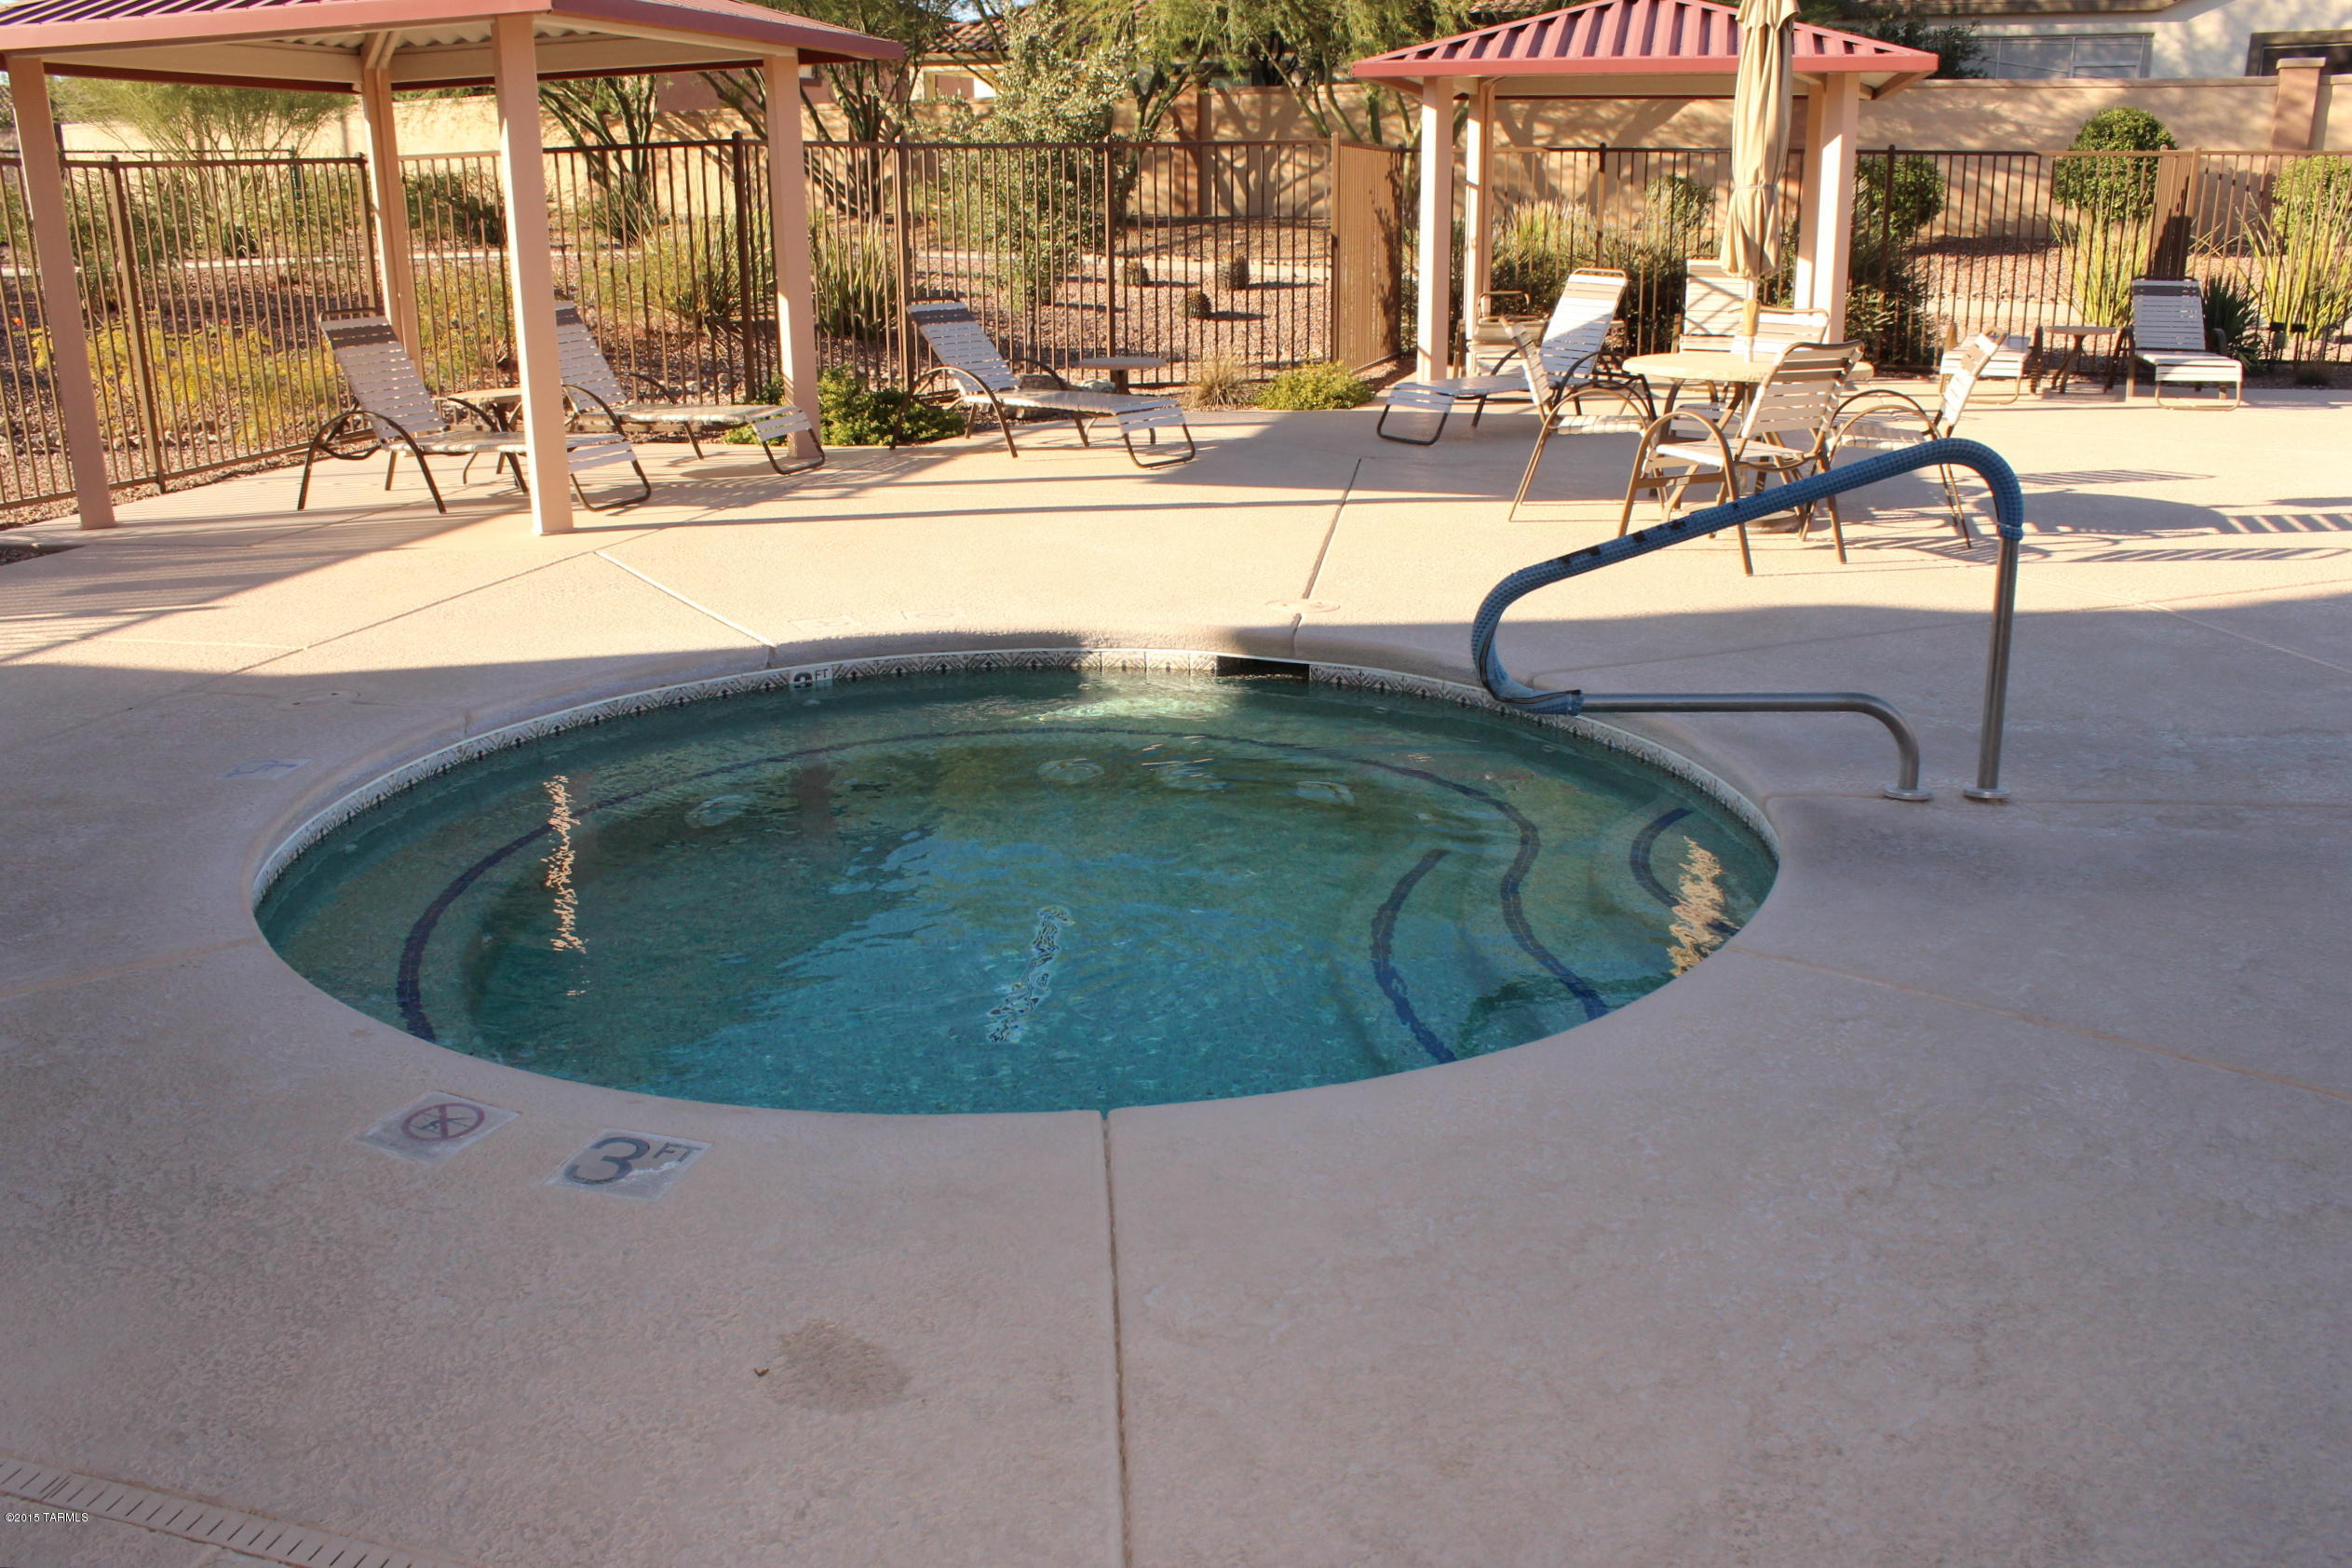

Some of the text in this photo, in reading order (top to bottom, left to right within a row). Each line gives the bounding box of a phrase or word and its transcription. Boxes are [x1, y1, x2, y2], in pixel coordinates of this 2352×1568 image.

[815, 669, 829, 682] FT
[564, 1136, 703, 1184] 3 FT
